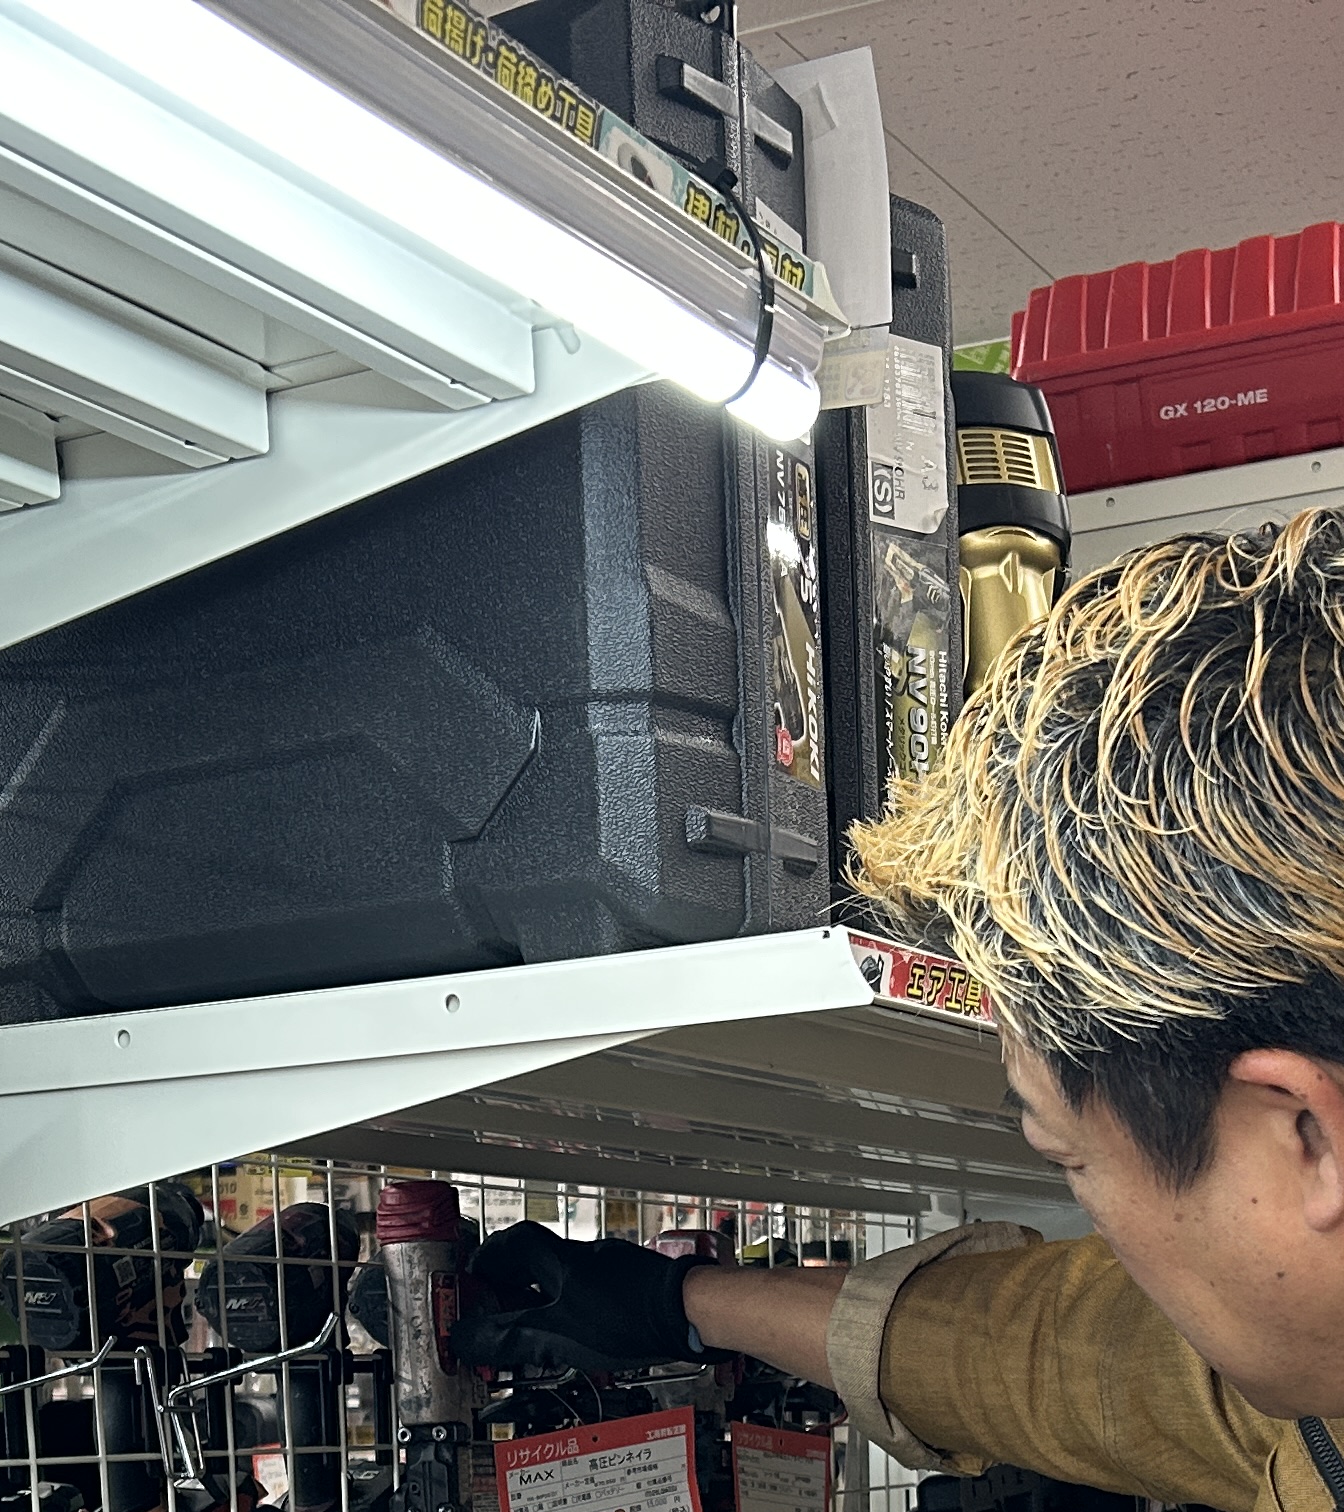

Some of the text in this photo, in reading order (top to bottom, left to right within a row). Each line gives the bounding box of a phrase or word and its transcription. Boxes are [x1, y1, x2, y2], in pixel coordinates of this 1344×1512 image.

[1159, 386, 1268, 421] GX 120-ME
[938, 651, 948, 708] Hitachi
[805, 640, 821, 782] HiKOKI
[507, 1438, 580, 1468] リサイクル品
[519, 1469, 554, 1486] MAX
